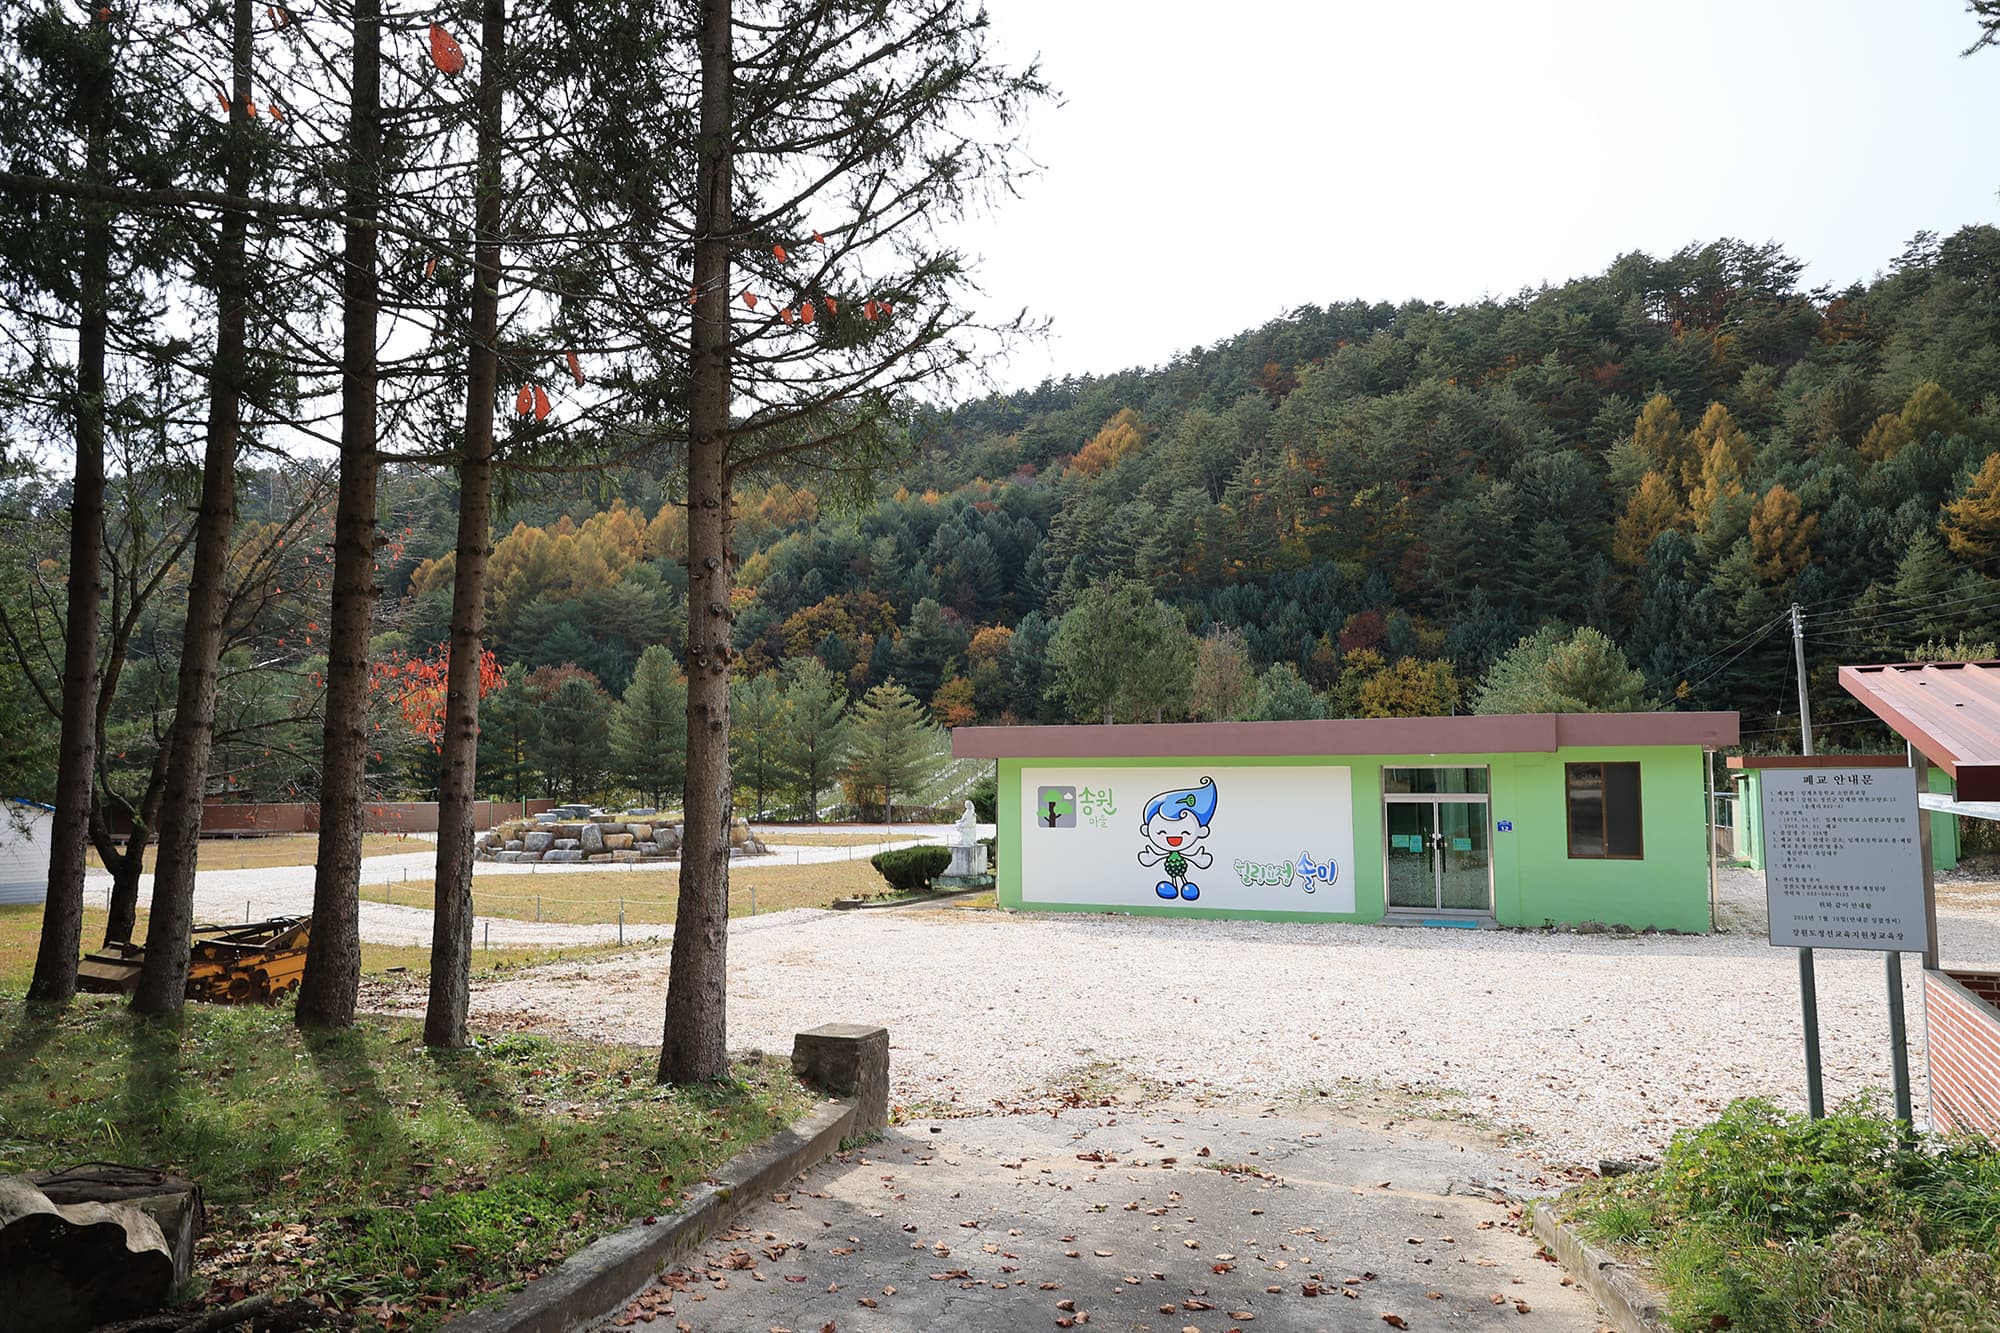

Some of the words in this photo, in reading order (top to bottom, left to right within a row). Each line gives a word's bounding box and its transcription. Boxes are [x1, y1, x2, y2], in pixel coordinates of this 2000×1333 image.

[1802, 775, 1828, 786] 폐교
[1833, 774, 1874, 786] 안내문
[1078, 786, 1117, 816] 송원
[1089, 815, 1109, 829] 마을
[1234, 859, 1294, 886] 힐링요정
